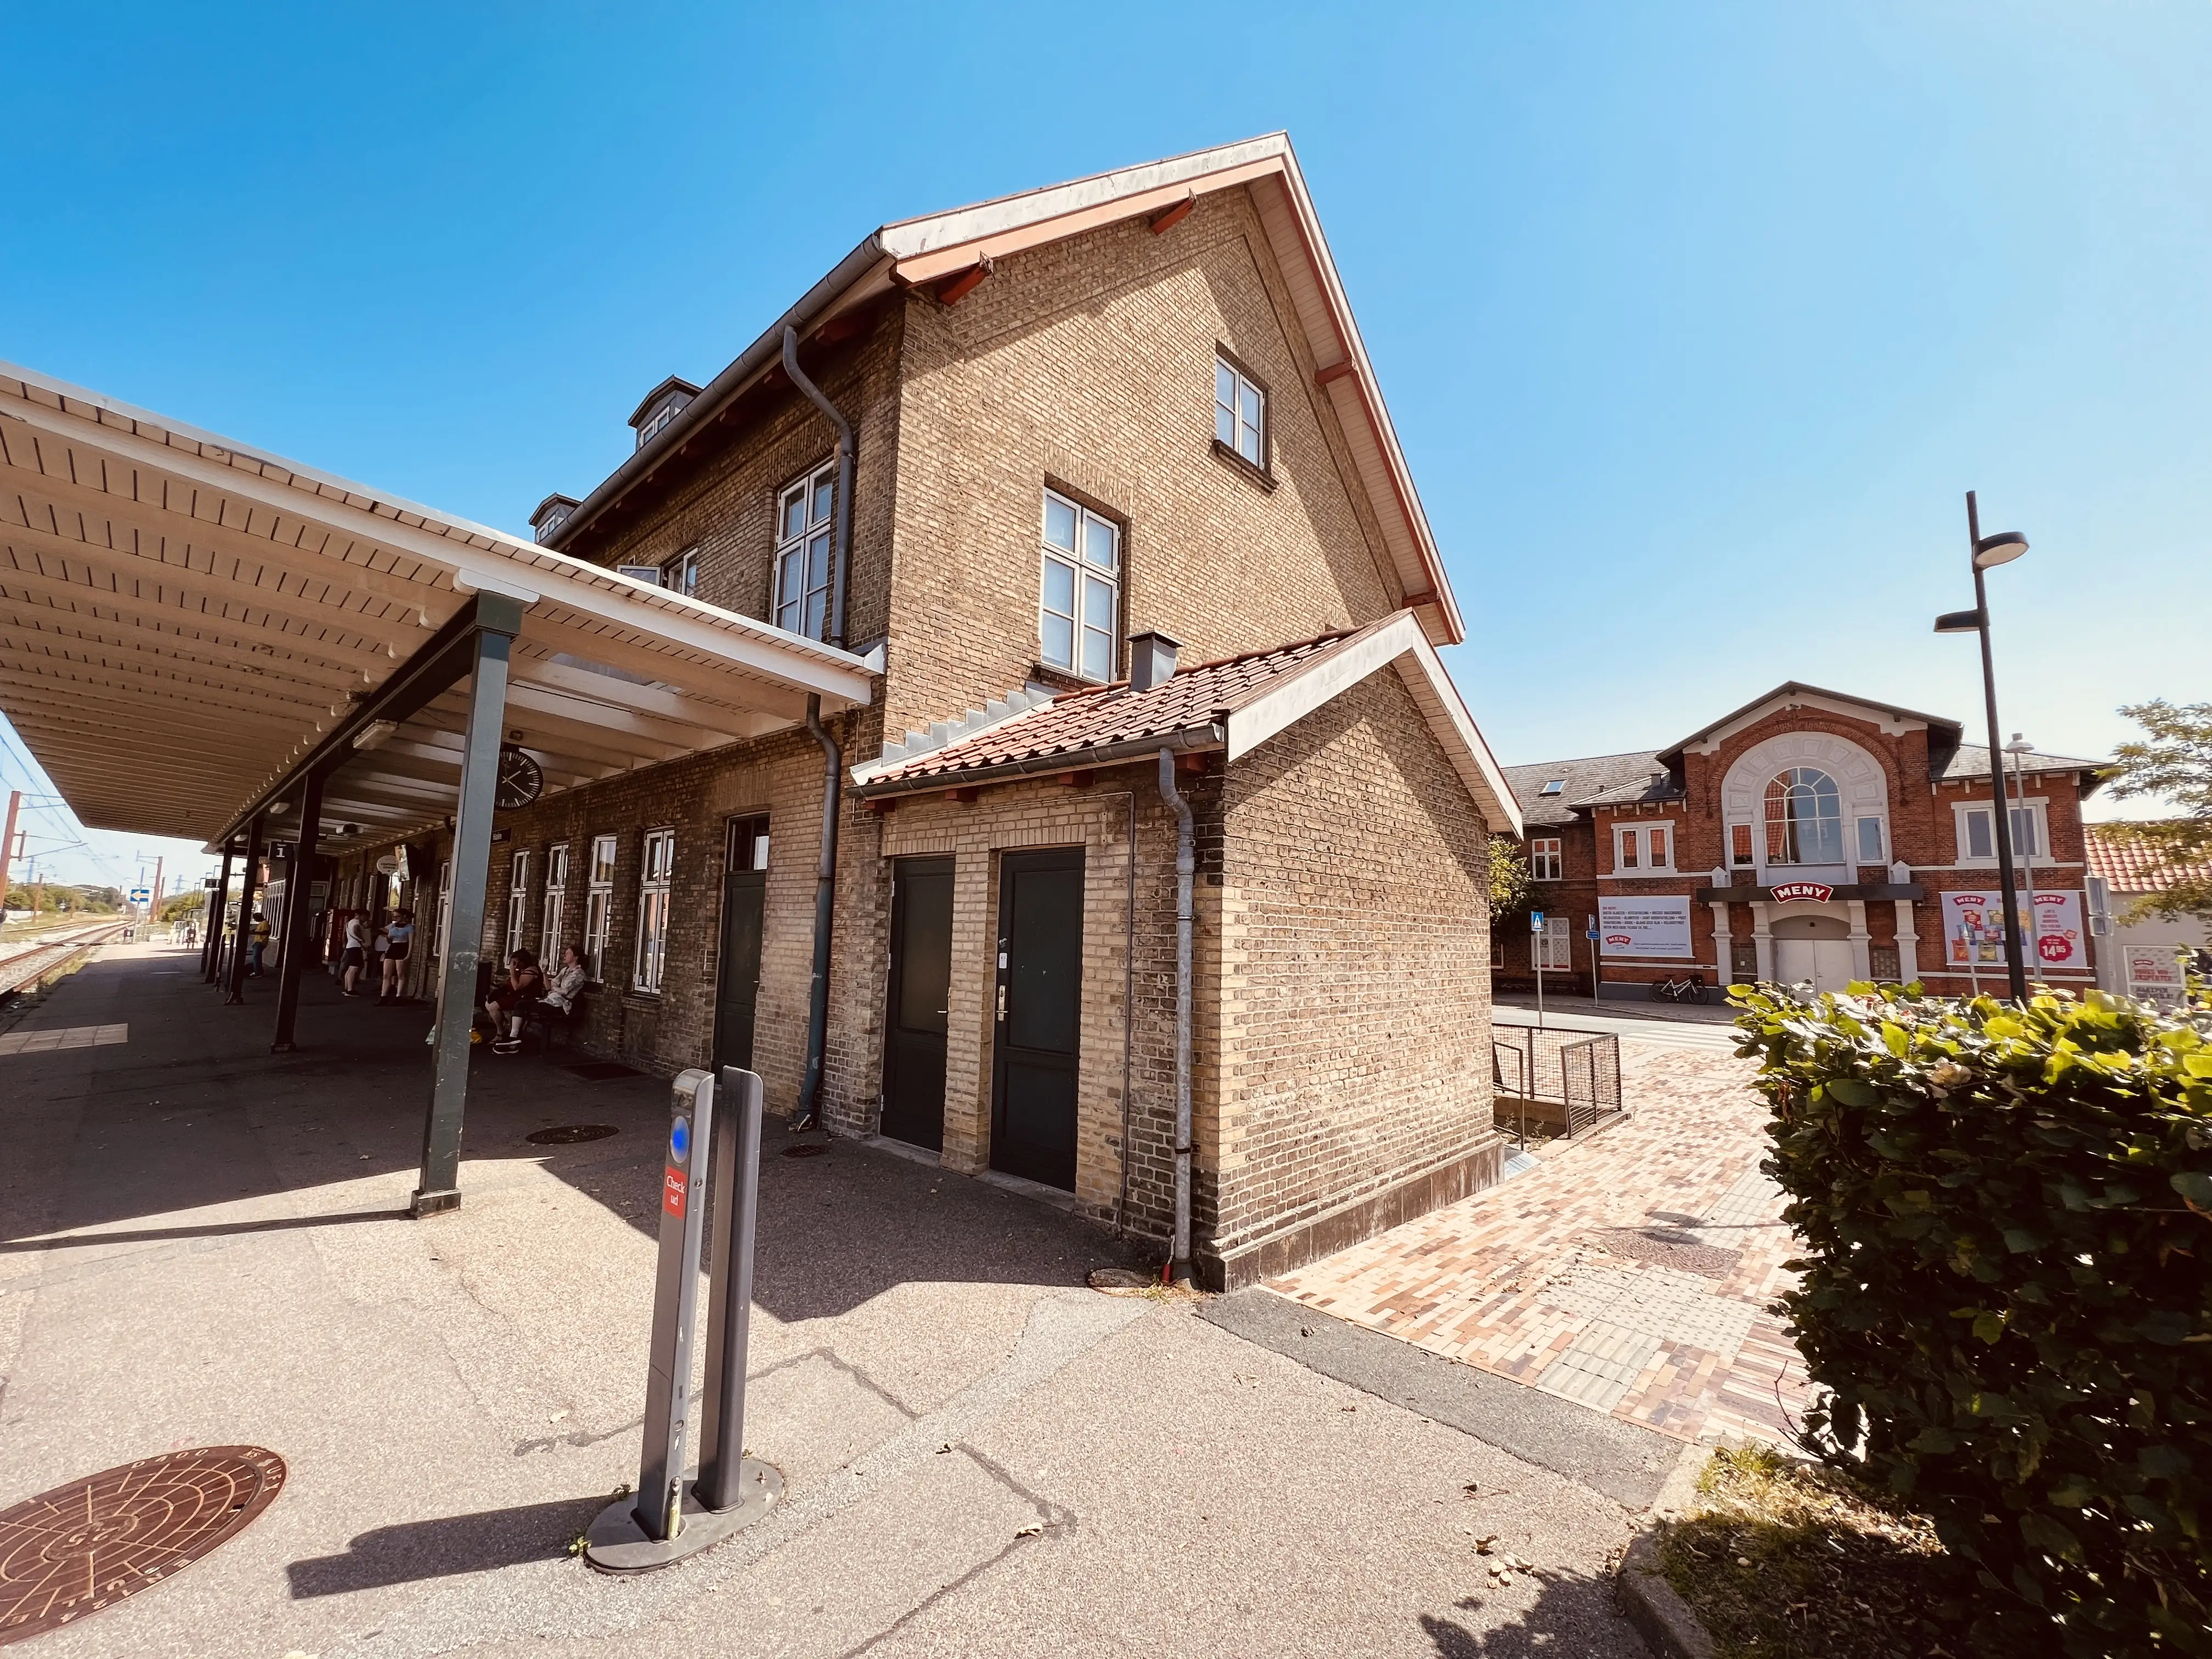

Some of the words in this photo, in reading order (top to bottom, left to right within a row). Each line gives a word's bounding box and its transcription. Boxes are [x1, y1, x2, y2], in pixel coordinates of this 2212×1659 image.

[276, 848, 285, 857] 1
[1777, 885, 1826, 898] MENY
[667, 1175, 685, 1194] Check
[670, 1194, 679, 1206] ud
